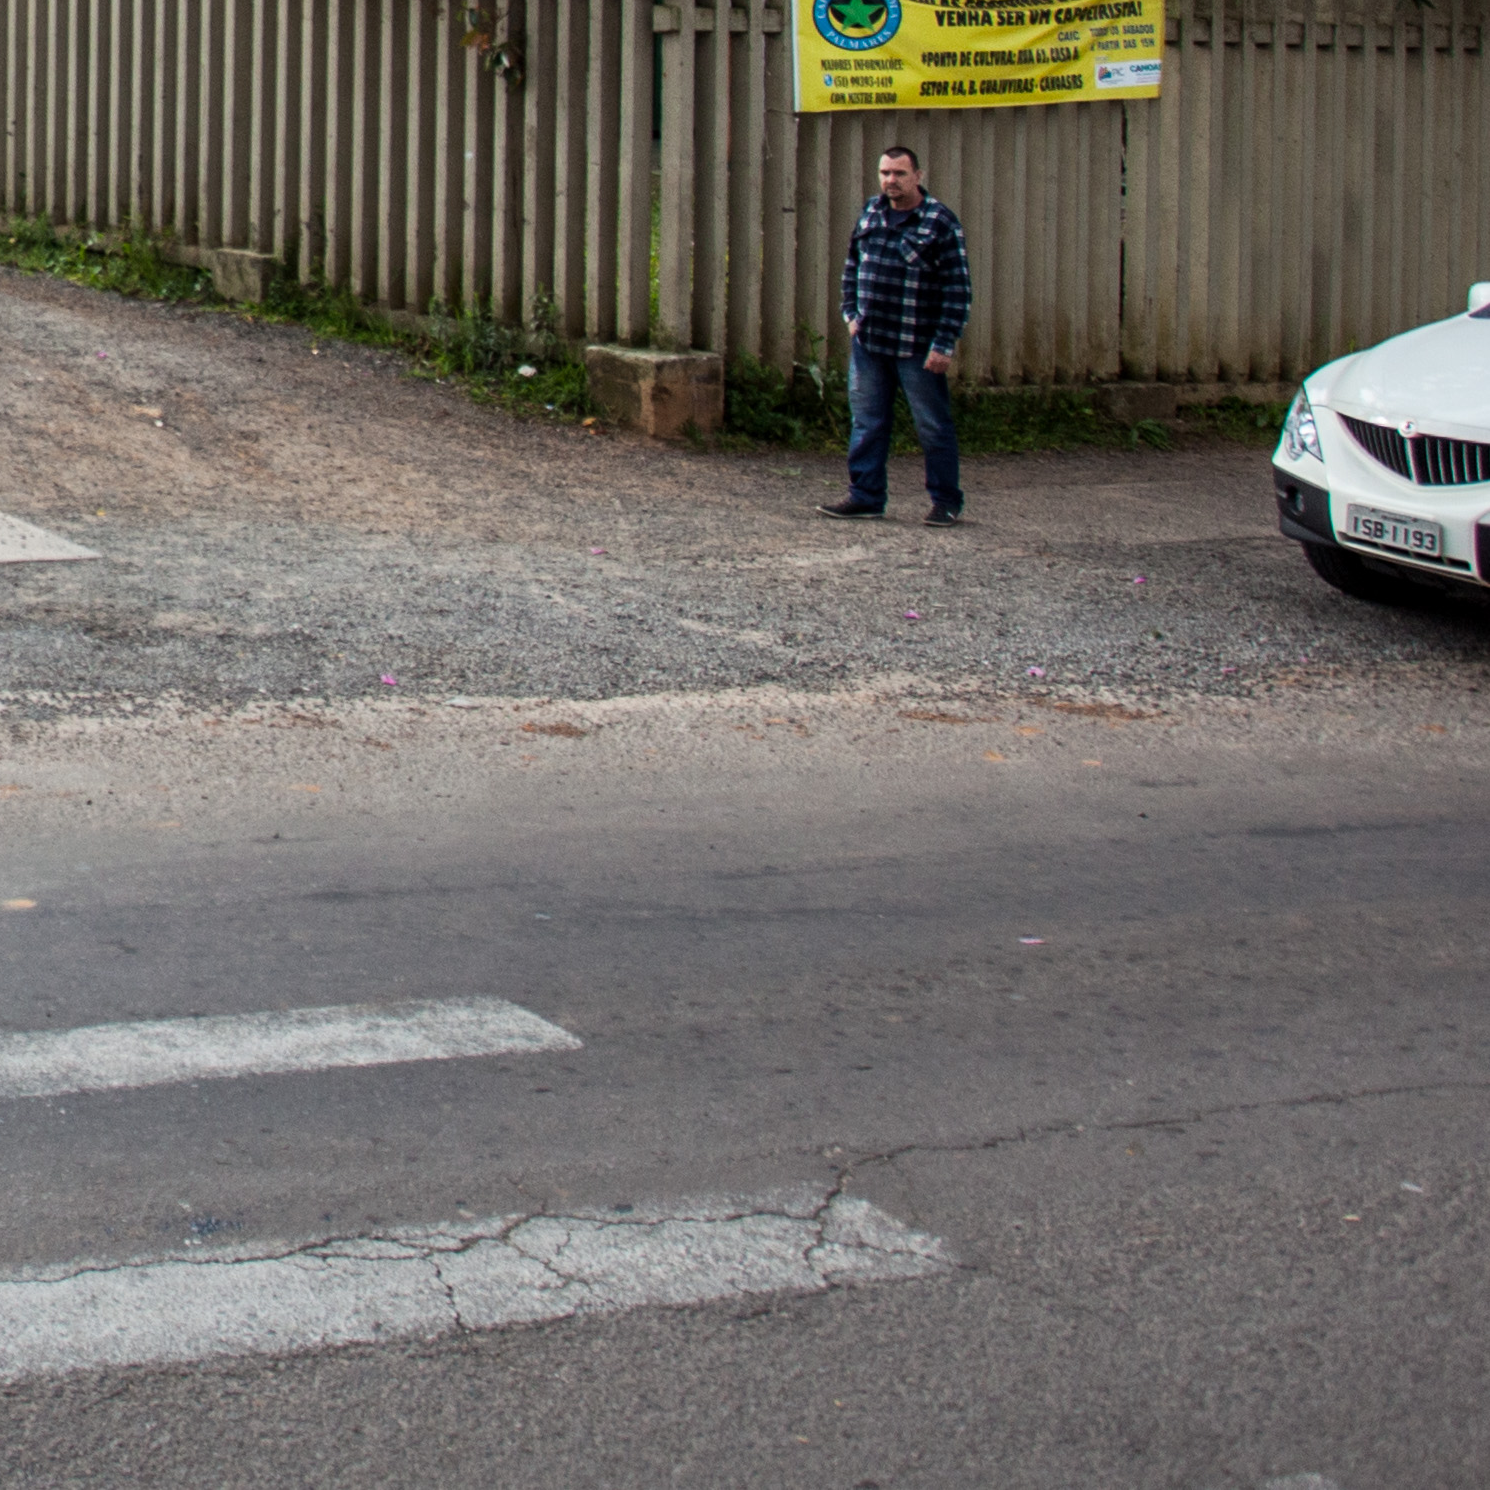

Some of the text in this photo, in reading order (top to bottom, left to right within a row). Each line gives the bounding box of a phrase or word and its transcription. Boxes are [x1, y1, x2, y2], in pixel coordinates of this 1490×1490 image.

[935, 10, 993, 26] VENHA
[996, 10, 1025, 26] SER
[1029, 9, 1051, 25] UM
[1123, 39, 1137, 49] DAS
[959, 51, 972, 66] DE
[1050, 47, 1071, 62] CASA
[920, 81, 949, 96] SETOR
[1353, 516, 1436, 551] ISB-1193
